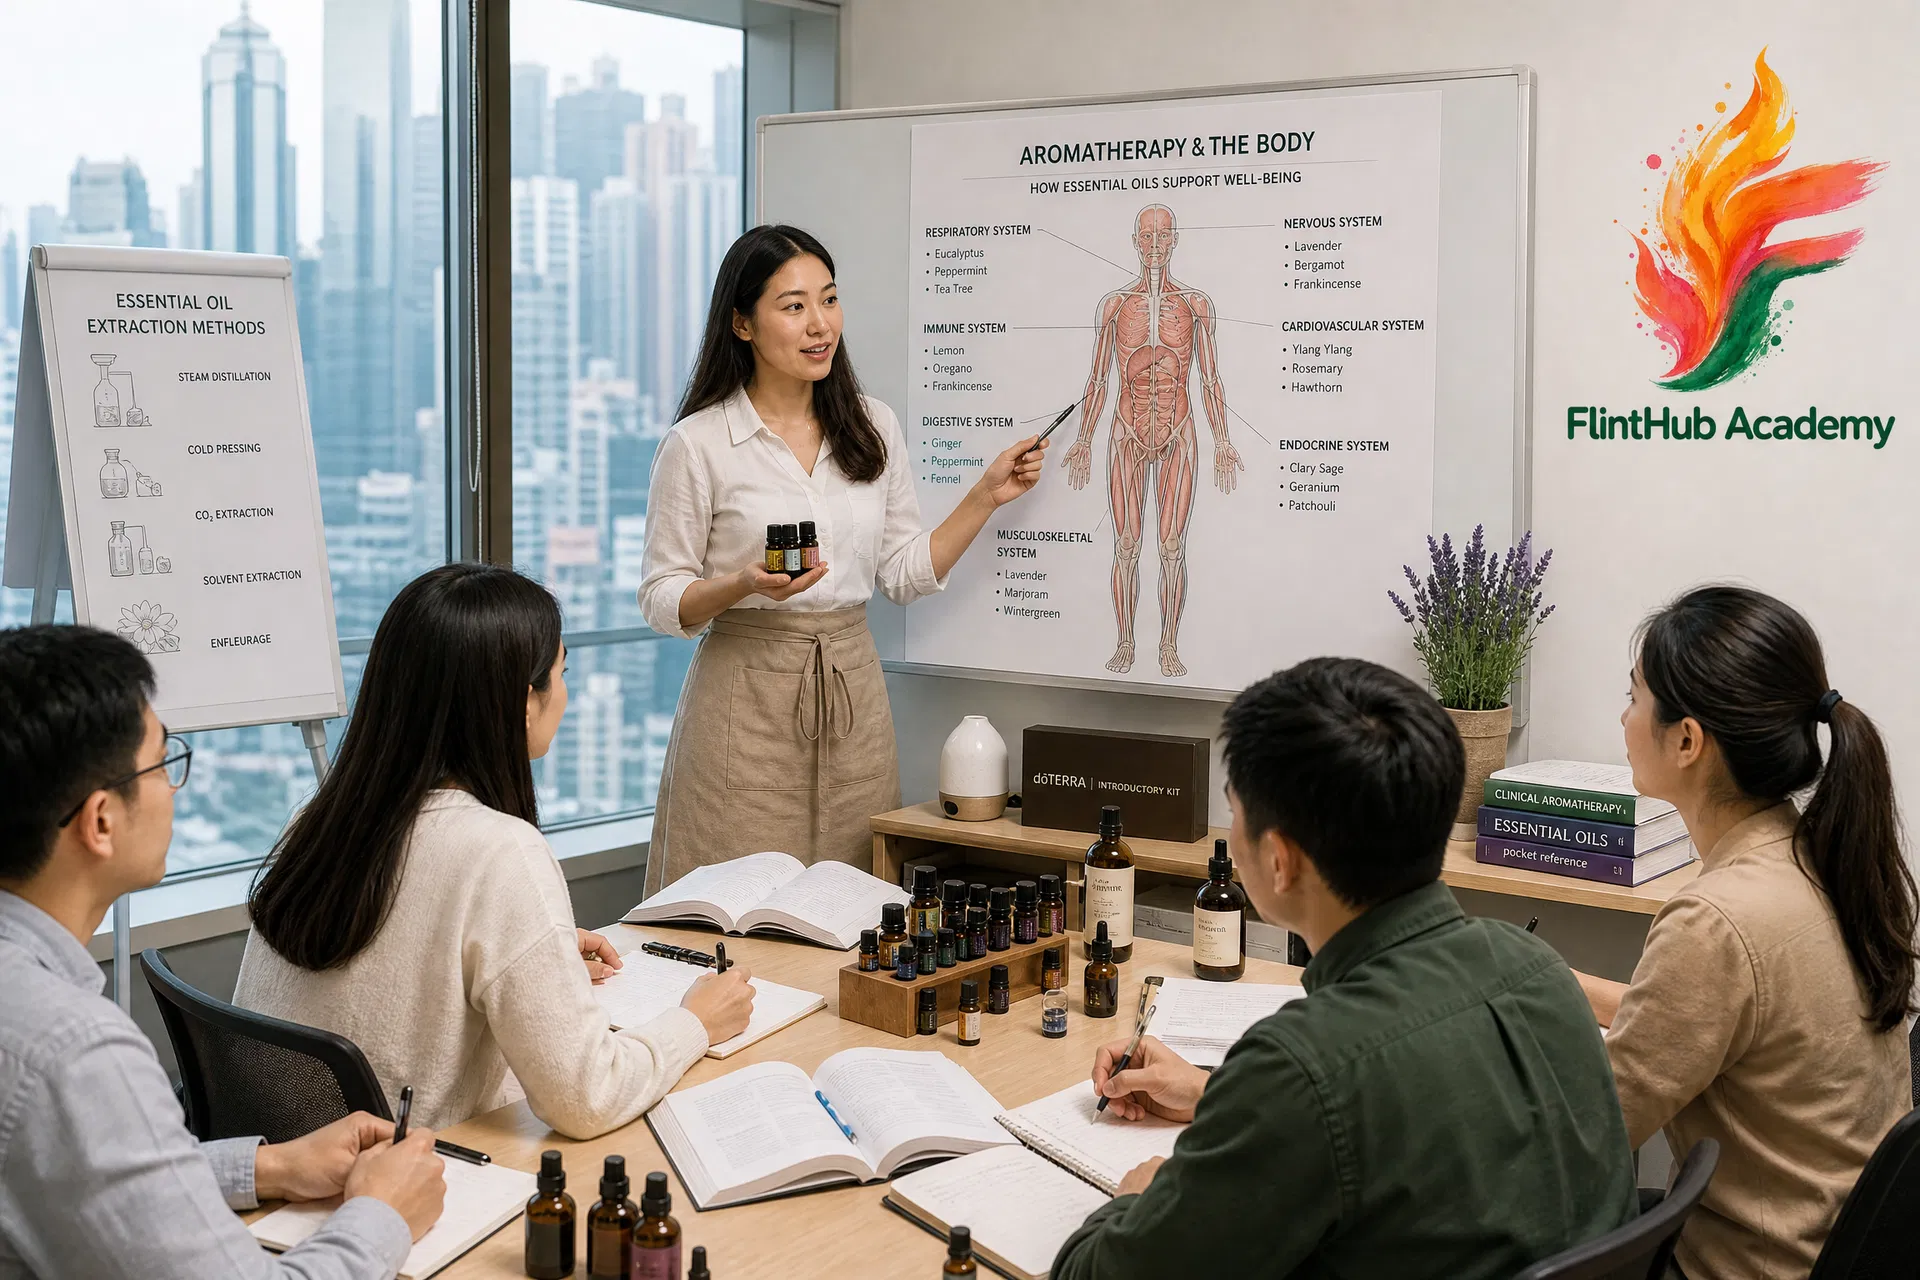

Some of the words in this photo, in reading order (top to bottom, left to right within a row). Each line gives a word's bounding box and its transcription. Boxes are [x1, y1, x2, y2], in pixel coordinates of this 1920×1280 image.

[1019, 137, 1188, 166] AROMATHERAPY
[1191, 136, 1206, 157] &
[1208, 134, 1250, 156] THE
[1256, 130, 1316, 154] BODY
[1030, 181, 1060, 194] HOW
[1063, 178, 1128, 193] ESSENTIAL
[1131, 177, 1159, 190] OILS
[1162, 174, 1221, 189] SUPPORT
[1223, 171, 1302, 186] WELL-BEING
[1284, 217, 1336, 229] NERVOUS
[1338, 215, 1382, 228] SYSTEM
[925, 225, 991, 238] RESPIRATORY
[992, 224, 1031, 236] SYSTEM
[1294, 240, 1343, 252] Lavender
[934, 248, 985, 261] Eucalyptus
[934, 265, 988, 279] Peppermint
[1294, 259, 1345, 273] Bergamot
[933, 283, 951, 294] Tea
[952, 283, 973, 294] Tree
[1293, 278, 1362, 290] Frankincense
[116, 293, 203, 310] ESSENTIAL
[206, 295, 234, 310] OIL
[87, 318, 188, 335] EXTRACTION
[192, 320, 266, 335] METHODS
[923, 323, 965, 334] IMMUNE
[967, 322, 1006, 334] SYSTEM
[1281, 320, 1379, 332] CARDIOVASCULAR
[1381, 319, 1425, 331] SYSTEM
[932, 345, 965, 356] Lemon
[1292, 343, 1321, 358] Ylang
[1323, 343, 1353, 358] Ylang
[932, 363, 973, 376] Oregano
[1292, 362, 1344, 376] Rosemary
[178, 372, 210, 382] STEAM
[211, 371, 272, 382] DISTILLATION
[932, 380, 993, 392] Frankincense
[1291, 381, 1343, 393] Hawthorn
[922, 416, 973, 427] DIGESTIVE
[974, 416, 1014, 428] SYSTEM
[1567, 405, 1717, 441] FlintHub
[1724, 405, 1896, 450] Academy
[187, 444, 214, 455] COLD
[216, 443, 262, 454] PRESSING
[931, 437, 963, 451] Ginger
[1279, 439, 1344, 451] ENDOCRINE
[1346, 440, 1390, 452] SYSTEM
[931, 455, 984, 469] Peppermint
[1289, 462, 1317, 476] Clary
[1318, 462, 1344, 477] Sage
[930, 473, 961, 484] Fennel
[1289, 481, 1340, 493] Geranium
[1288, 499, 1336, 512] Patchouli
[215, 507, 274, 520] EXTRACTION
[996, 529, 1093, 543] MUSCULOSKELETAL
[996, 546, 1037, 559] SYSTEM
[202, 573, 244, 586] SOLVENT
[245, 569, 302, 583] EXTRACTION
[1004, 569, 1048, 581] Lavender
[1004, 587, 1049, 600] Marjoram
[1003, 605, 1061, 620] Wintergreen
[210, 633, 272, 649] ENFLEURAGE
[1098, 780, 1165, 795] INTRODUCTORY
[1166, 787, 1181, 796] KIT
[1494, 788, 1540, 804] CLINICAL
[1541, 795, 1623, 815] AROMATHERAPY
[1494, 817, 1572, 842] ESSENTIAL
[1575, 830, 1609, 848] OILS
[1503, 846, 1538, 860] pocket
[1539, 852, 1588, 869] reference
